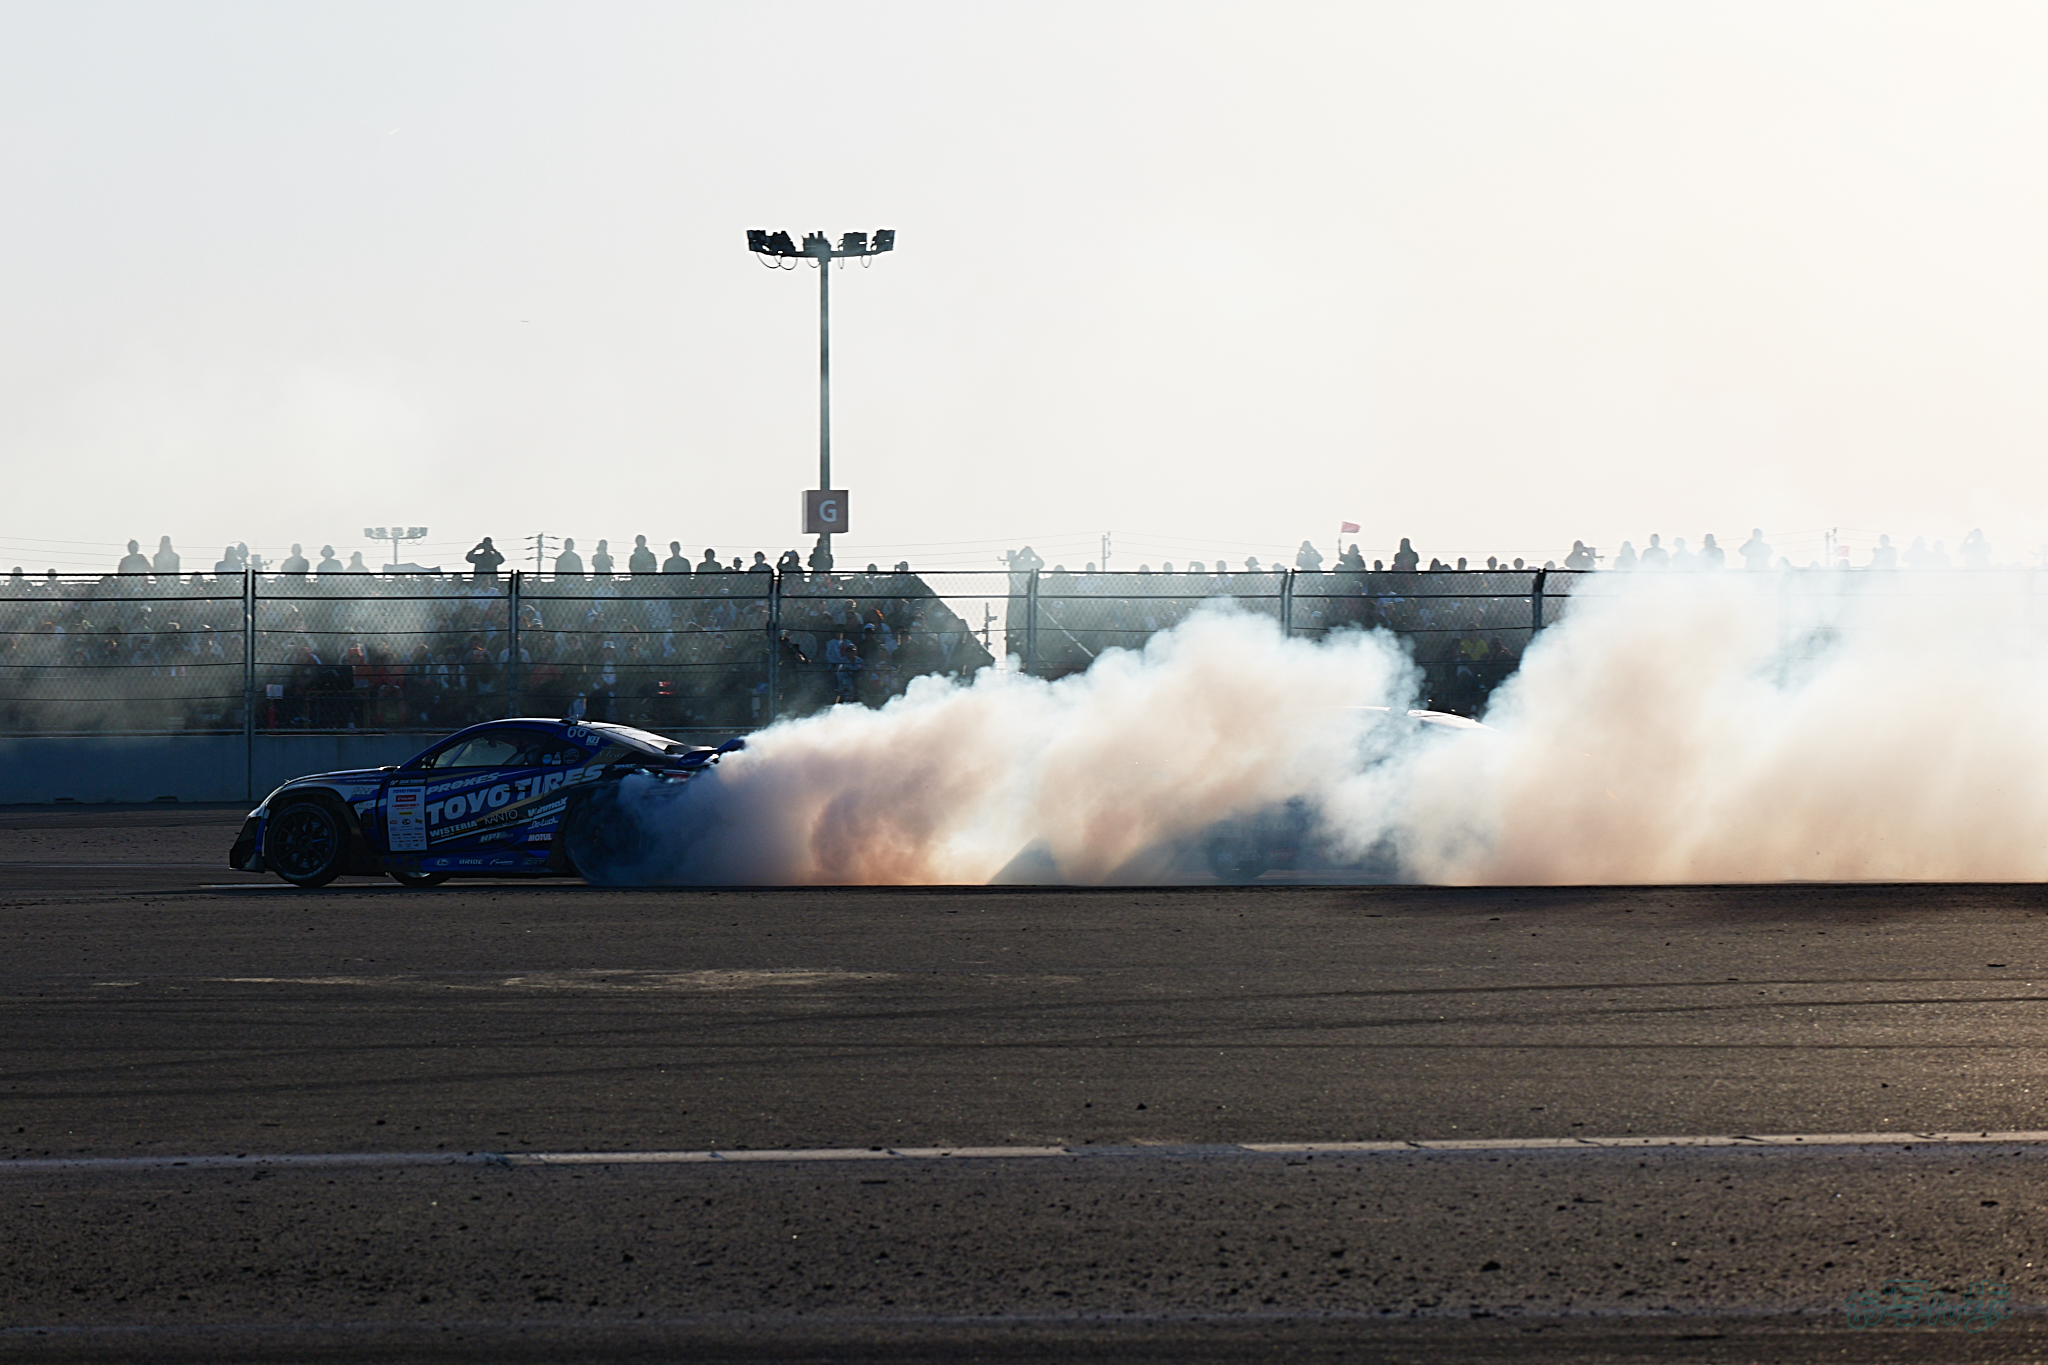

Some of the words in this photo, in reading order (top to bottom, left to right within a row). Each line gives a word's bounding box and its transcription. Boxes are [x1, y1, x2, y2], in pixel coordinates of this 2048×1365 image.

[819, 500, 838, 522] G
[426, 771, 501, 796] PROXES
[425, 783, 511, 826] TOYO
[514, 764, 607, 802] TIRES
[484, 809, 519, 825] KANTO
[527, 796, 569, 818] Winmax
[429, 820, 478, 838] WISTERIA
[528, 833, 553, 843] MOTUL
[458, 858, 484, 866] BRIDE
